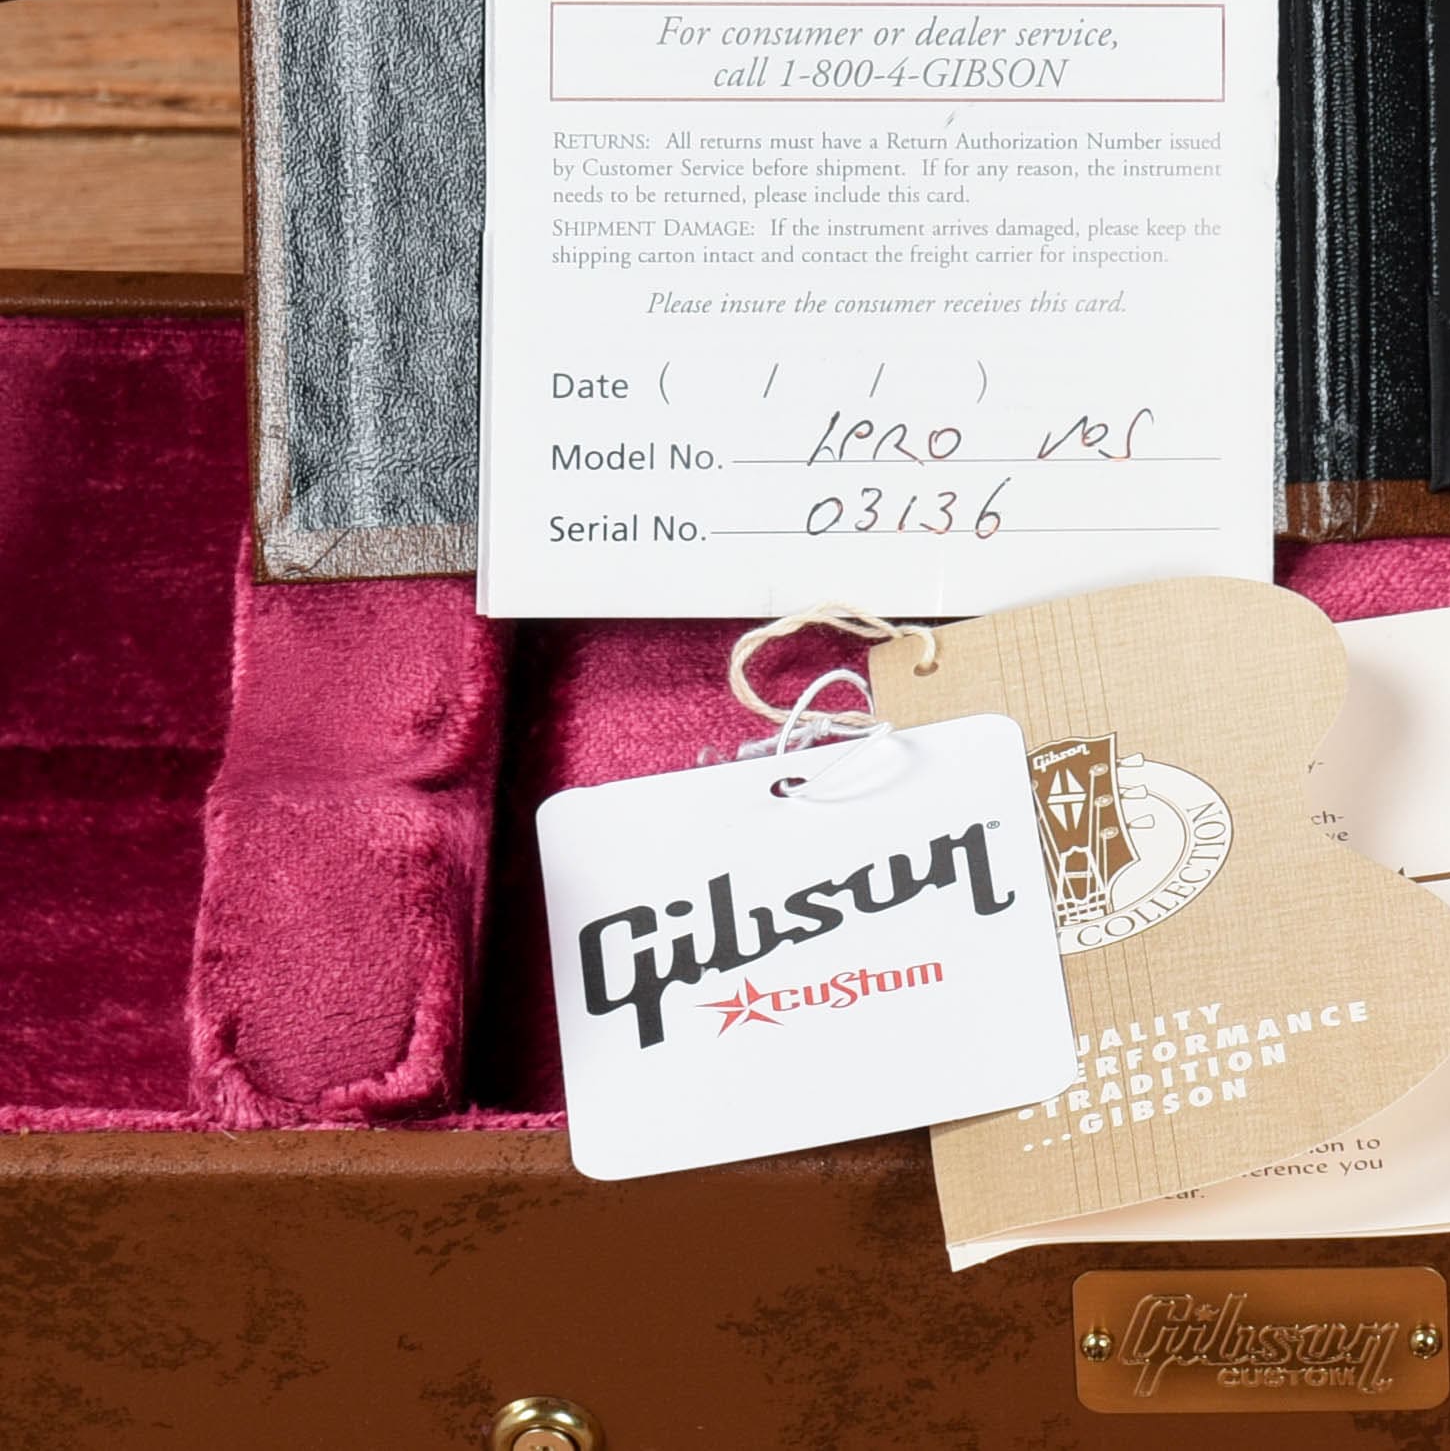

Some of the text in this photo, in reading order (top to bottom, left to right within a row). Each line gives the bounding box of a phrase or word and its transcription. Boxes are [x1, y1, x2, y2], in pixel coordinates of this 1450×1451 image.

[656, 13, 1118, 51] For consumer or dealer service,
[713, 55, 1070, 89] call 1-800-4-GIBSON
[553, 130, 1221, 152] RETURNS: All returns must have a Return Authorization Number issued
[647, 289, 1126, 315] Please insure the consumer receives this card.
[552, 371, 629, 400] Date
[552, 441, 723, 471] Model No.
[804, 476, 1015, 541] 03136
[549, 513, 707, 544] Serial No.
[1033, 743, 1090, 773] Gibson
[1076, 801, 1227, 947] COLLECTION
[578, 821, 1017, 1050] Gibson
[1076, 1001, 1369, 1084] ERFORMANCE
[1338, 1156, 1384, 1176] you
[1118, 1291, 1400, 1398] Gibson
[1216, 1366, 1358, 1389] CUSTOM
